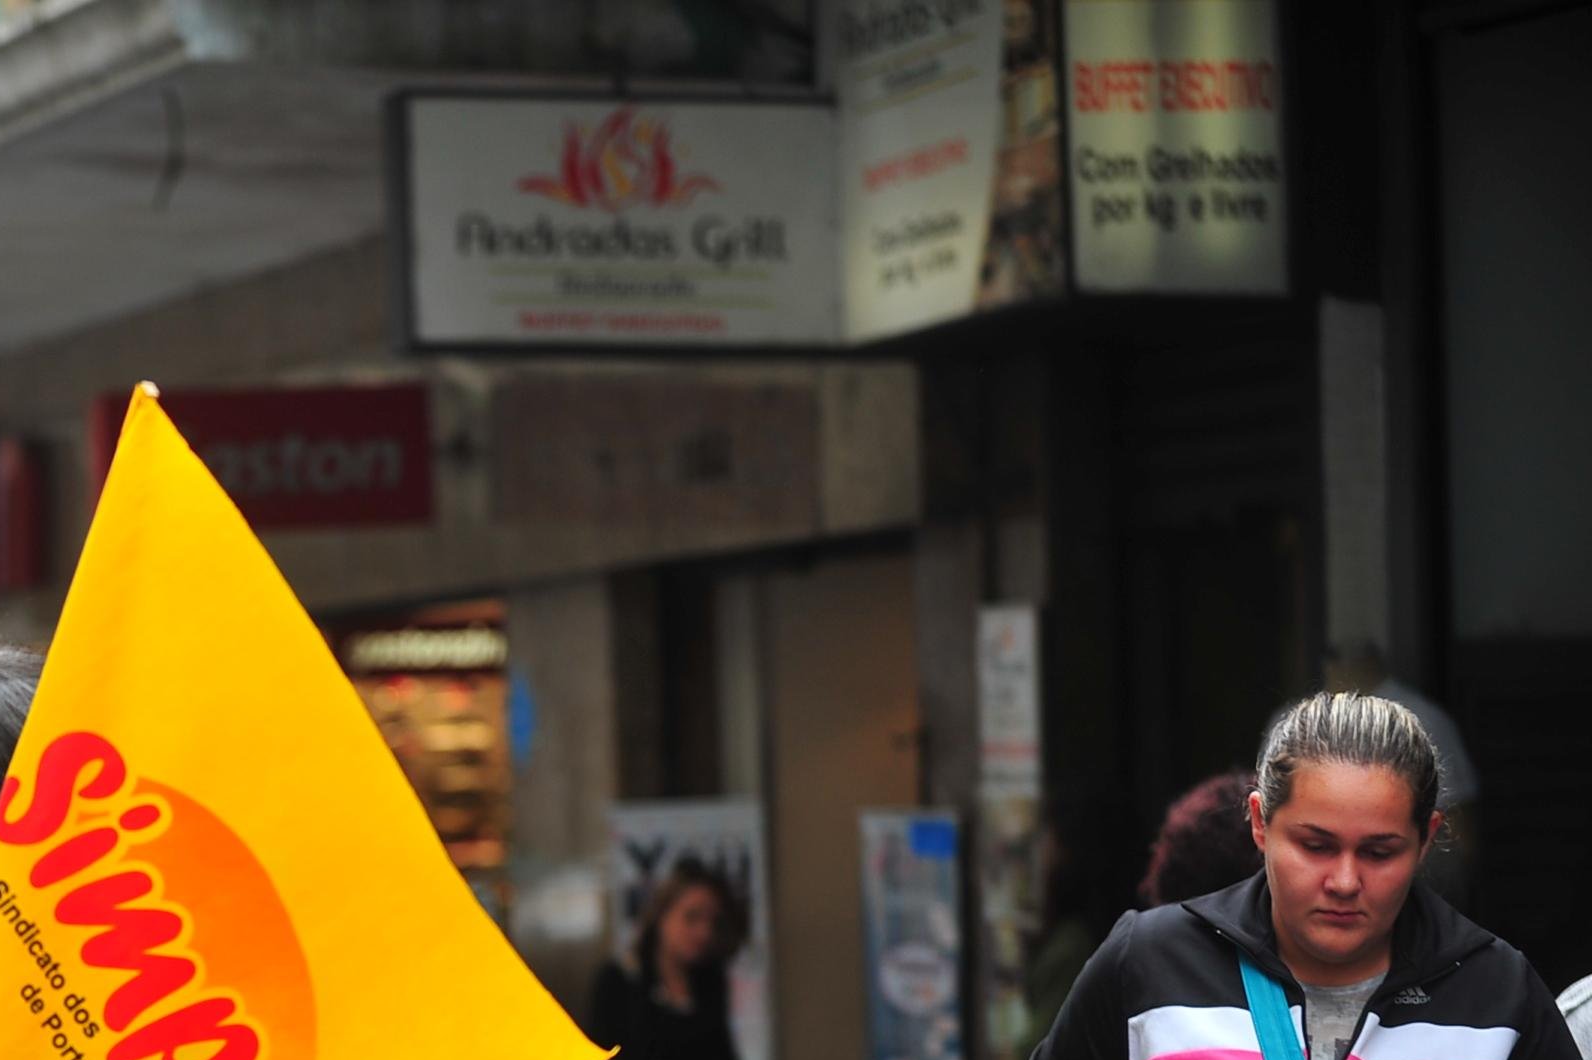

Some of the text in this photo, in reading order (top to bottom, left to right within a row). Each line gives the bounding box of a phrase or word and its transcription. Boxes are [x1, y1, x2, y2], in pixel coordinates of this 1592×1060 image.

[1077, 146, 1138, 182] Com
[1092, 192, 1136, 231] por
[690, 211, 790, 267] Grill
[20, 984, 45, 1014] de
[63, 993, 100, 1039] dos
